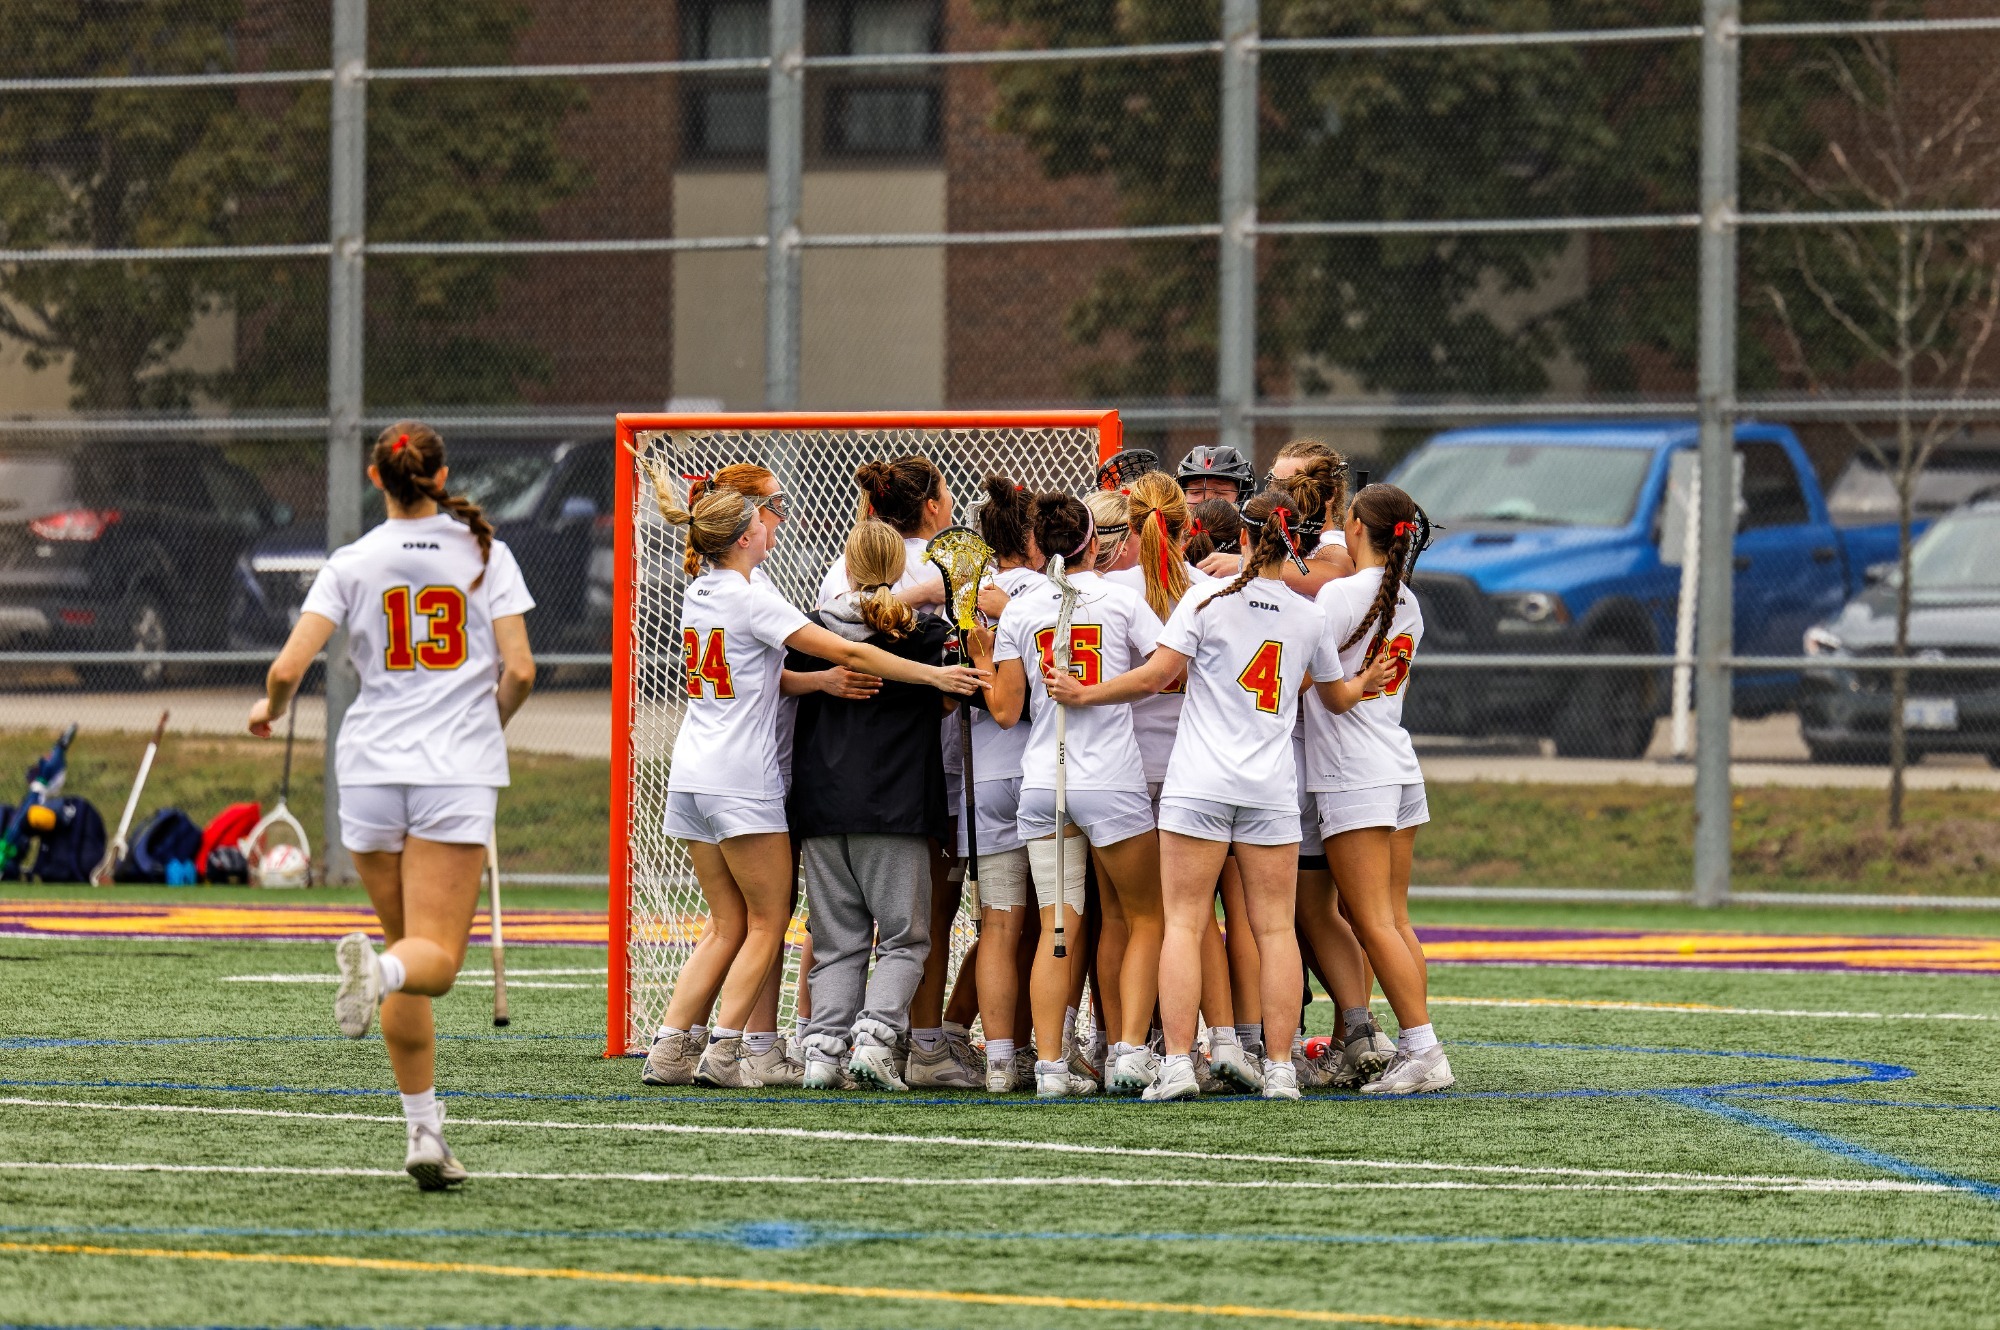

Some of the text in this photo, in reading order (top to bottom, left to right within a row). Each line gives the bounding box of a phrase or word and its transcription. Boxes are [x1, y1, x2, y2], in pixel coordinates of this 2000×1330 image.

[402, 542, 440, 551] OUA
[383, 585, 468, 671] 13
[1249, 600, 1281, 612] OUA
[683, 627, 736, 699] 24
[1034, 623, 1103, 699] 15
[1236, 640, 1283, 715] 4
